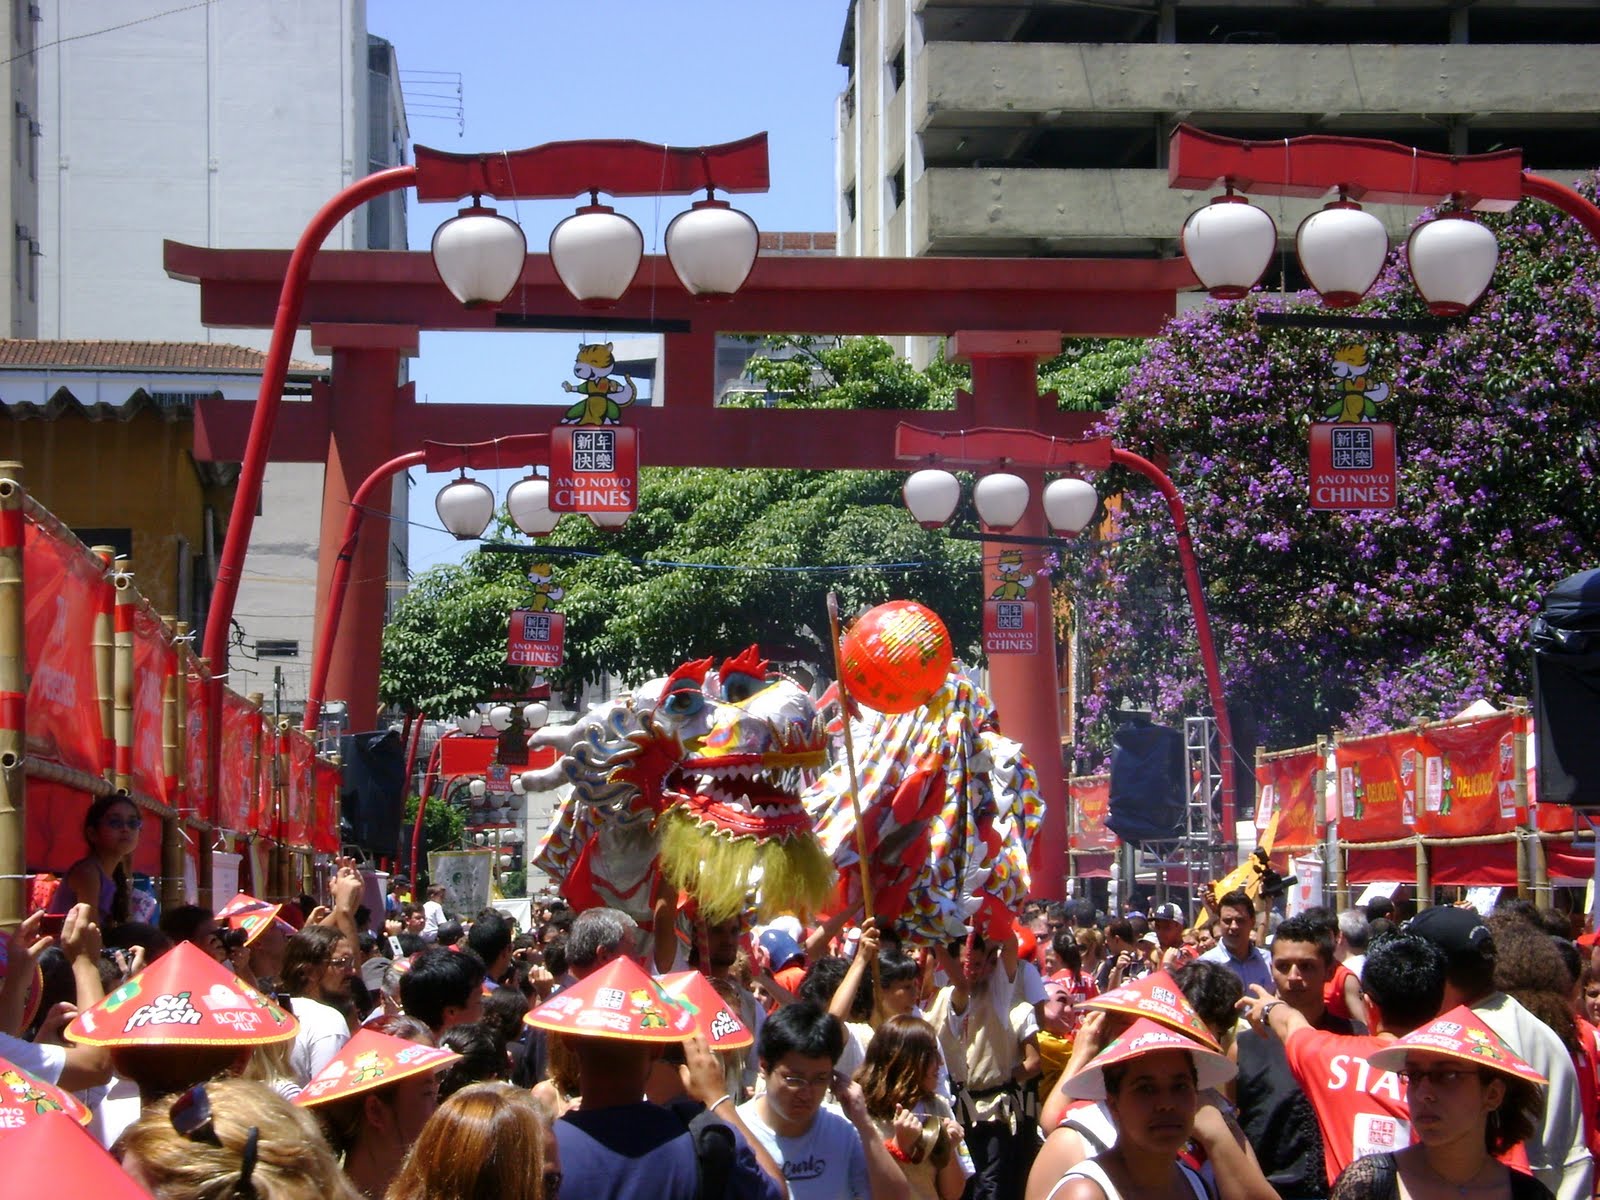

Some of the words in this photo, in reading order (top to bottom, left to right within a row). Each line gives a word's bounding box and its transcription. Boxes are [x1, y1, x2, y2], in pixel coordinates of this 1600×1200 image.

[577, 434, 611, 450] 新年
[556, 477, 586, 488] ANO
[590, 477, 631, 488] NOVO
[1316, 474, 1345, 484] ANO
[1349, 474, 1390, 484] NOVO
[533, 644, 560, 652] NOVO
[122, 1005, 203, 1034] fresh
[711, 1019, 741, 1041] fresh
[1327, 1054, 1408, 1104] STA
